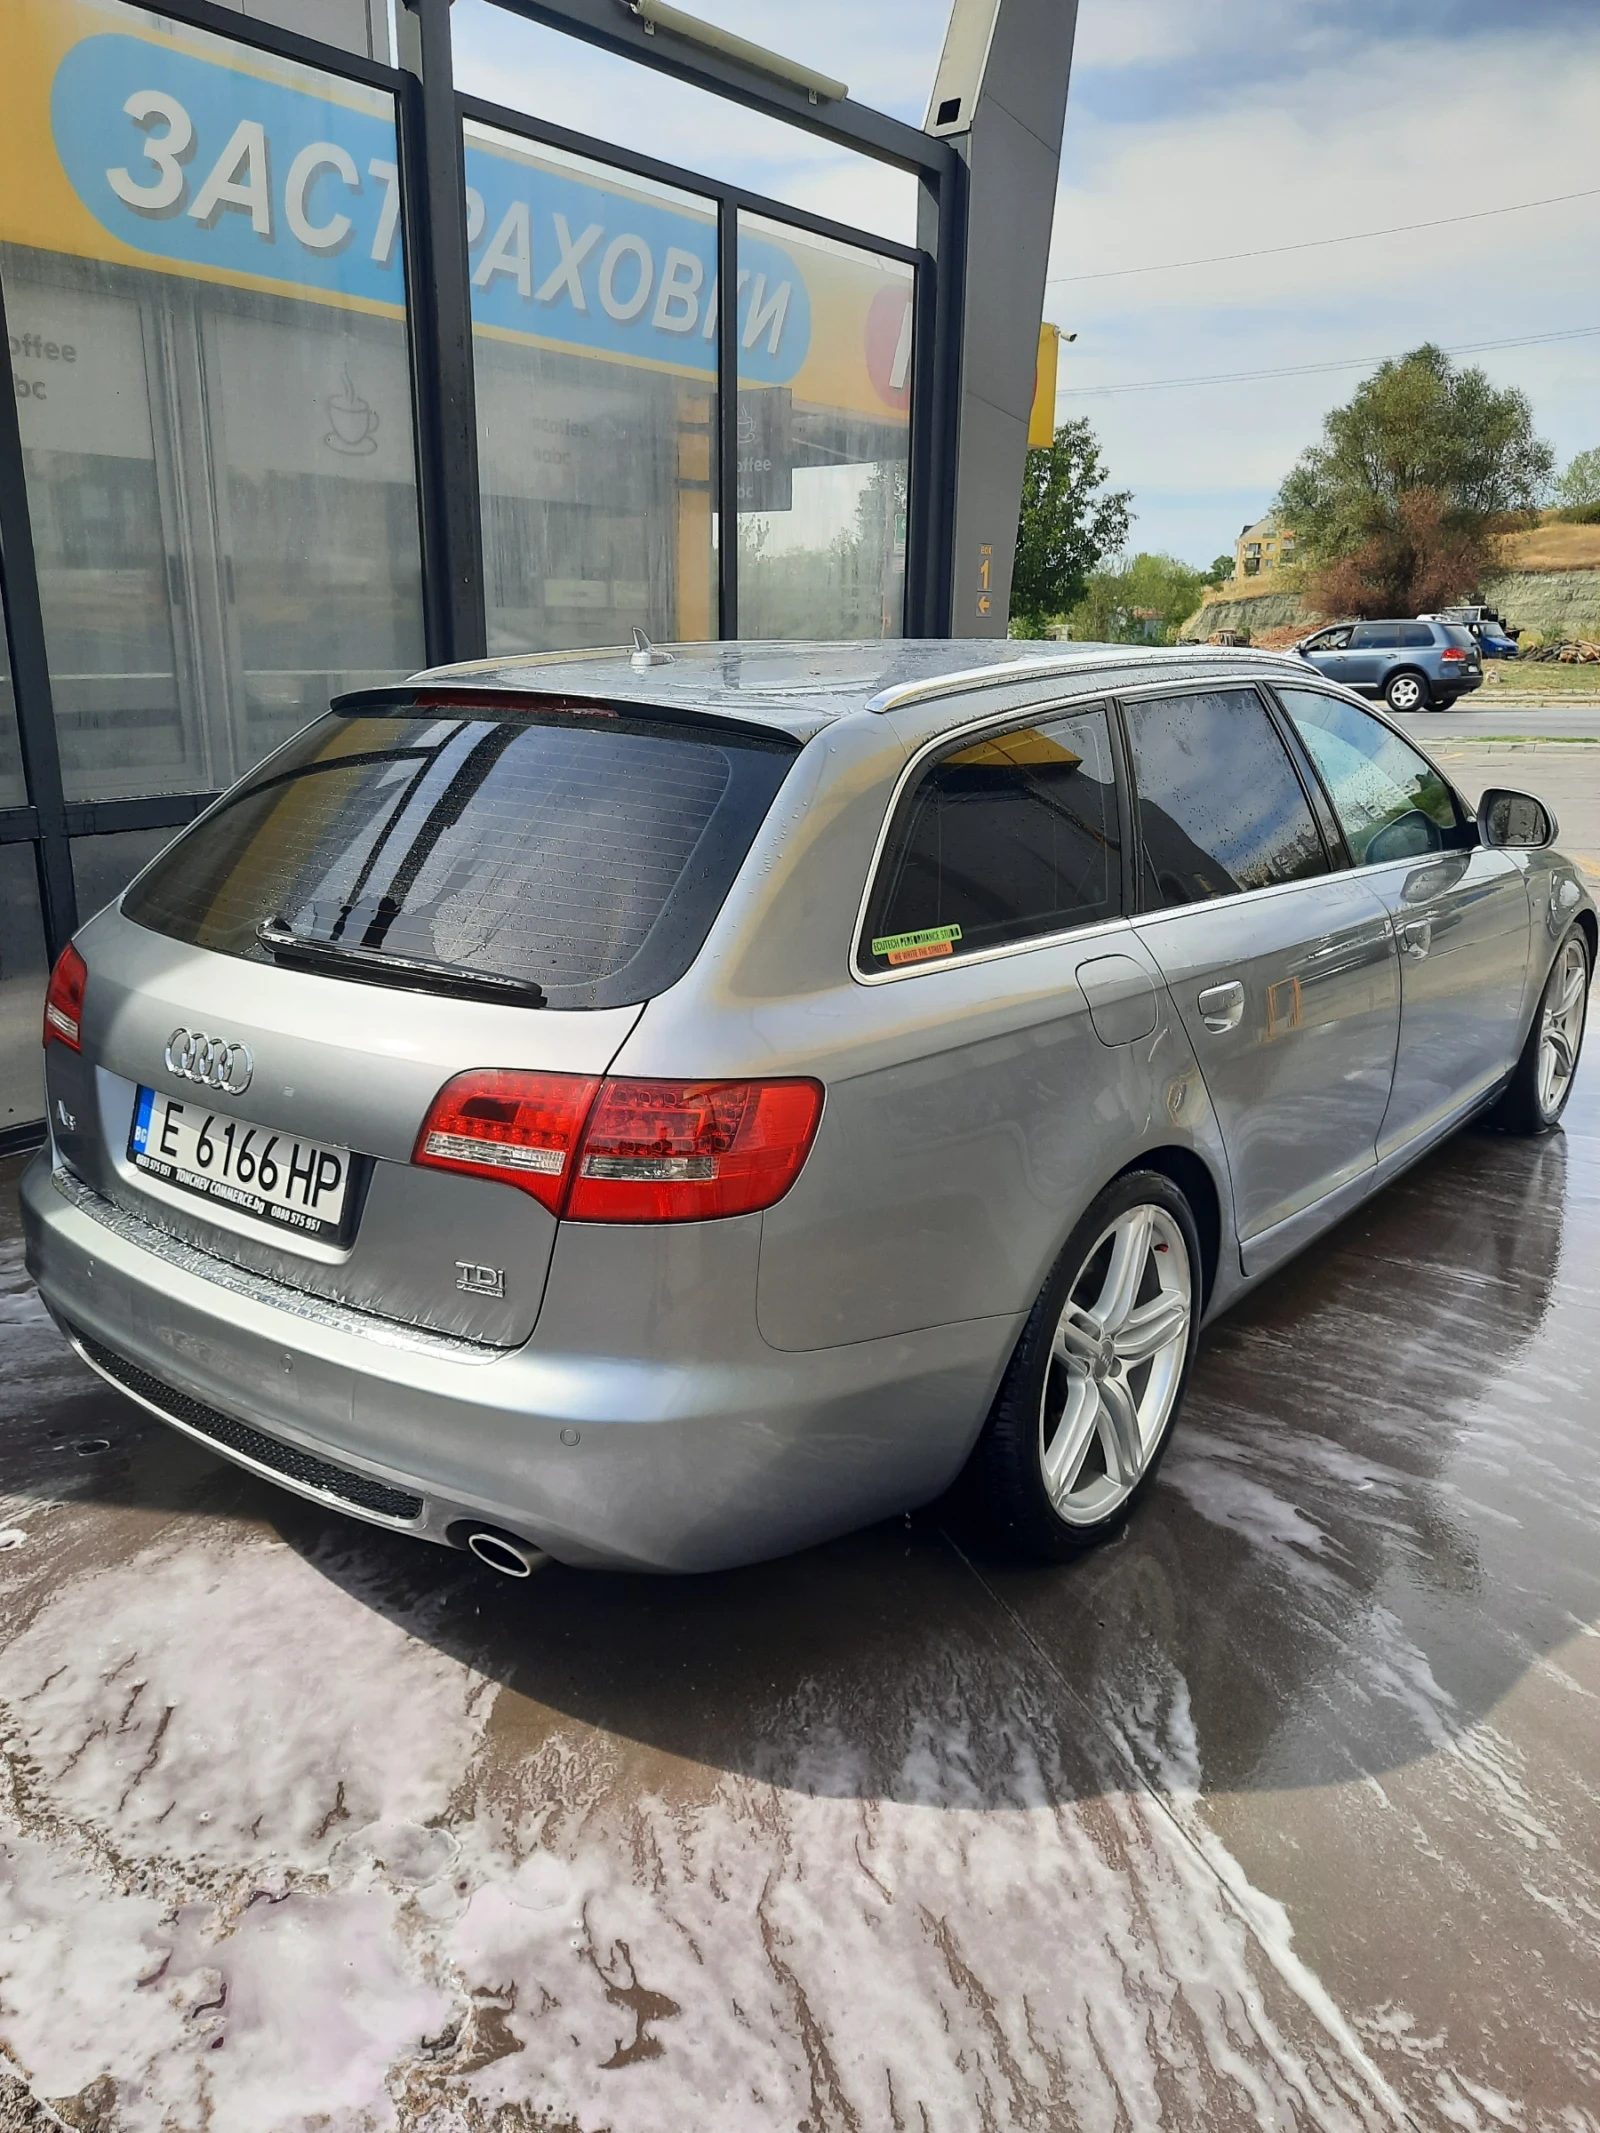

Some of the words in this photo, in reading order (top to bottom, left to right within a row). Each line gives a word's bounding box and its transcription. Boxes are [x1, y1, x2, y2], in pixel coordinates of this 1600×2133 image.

[980, 559, 990, 589] 1
[900, 931, 940, 947] PERFORMANCE
[134, 1125, 148, 1143] BG
[160, 1100, 184, 1157] E
[196, 1115, 279, 1191] 6166
[285, 1143, 341, 1207] HP
[176, 1168, 210, 1191] TONCHEV
[209, 1181, 265, 1215] COMMERCE.bg
[271, 1205, 290, 1221] 0888
[289, 1212, 305, 1227] 575
[305, 1217, 321, 1231] 951
